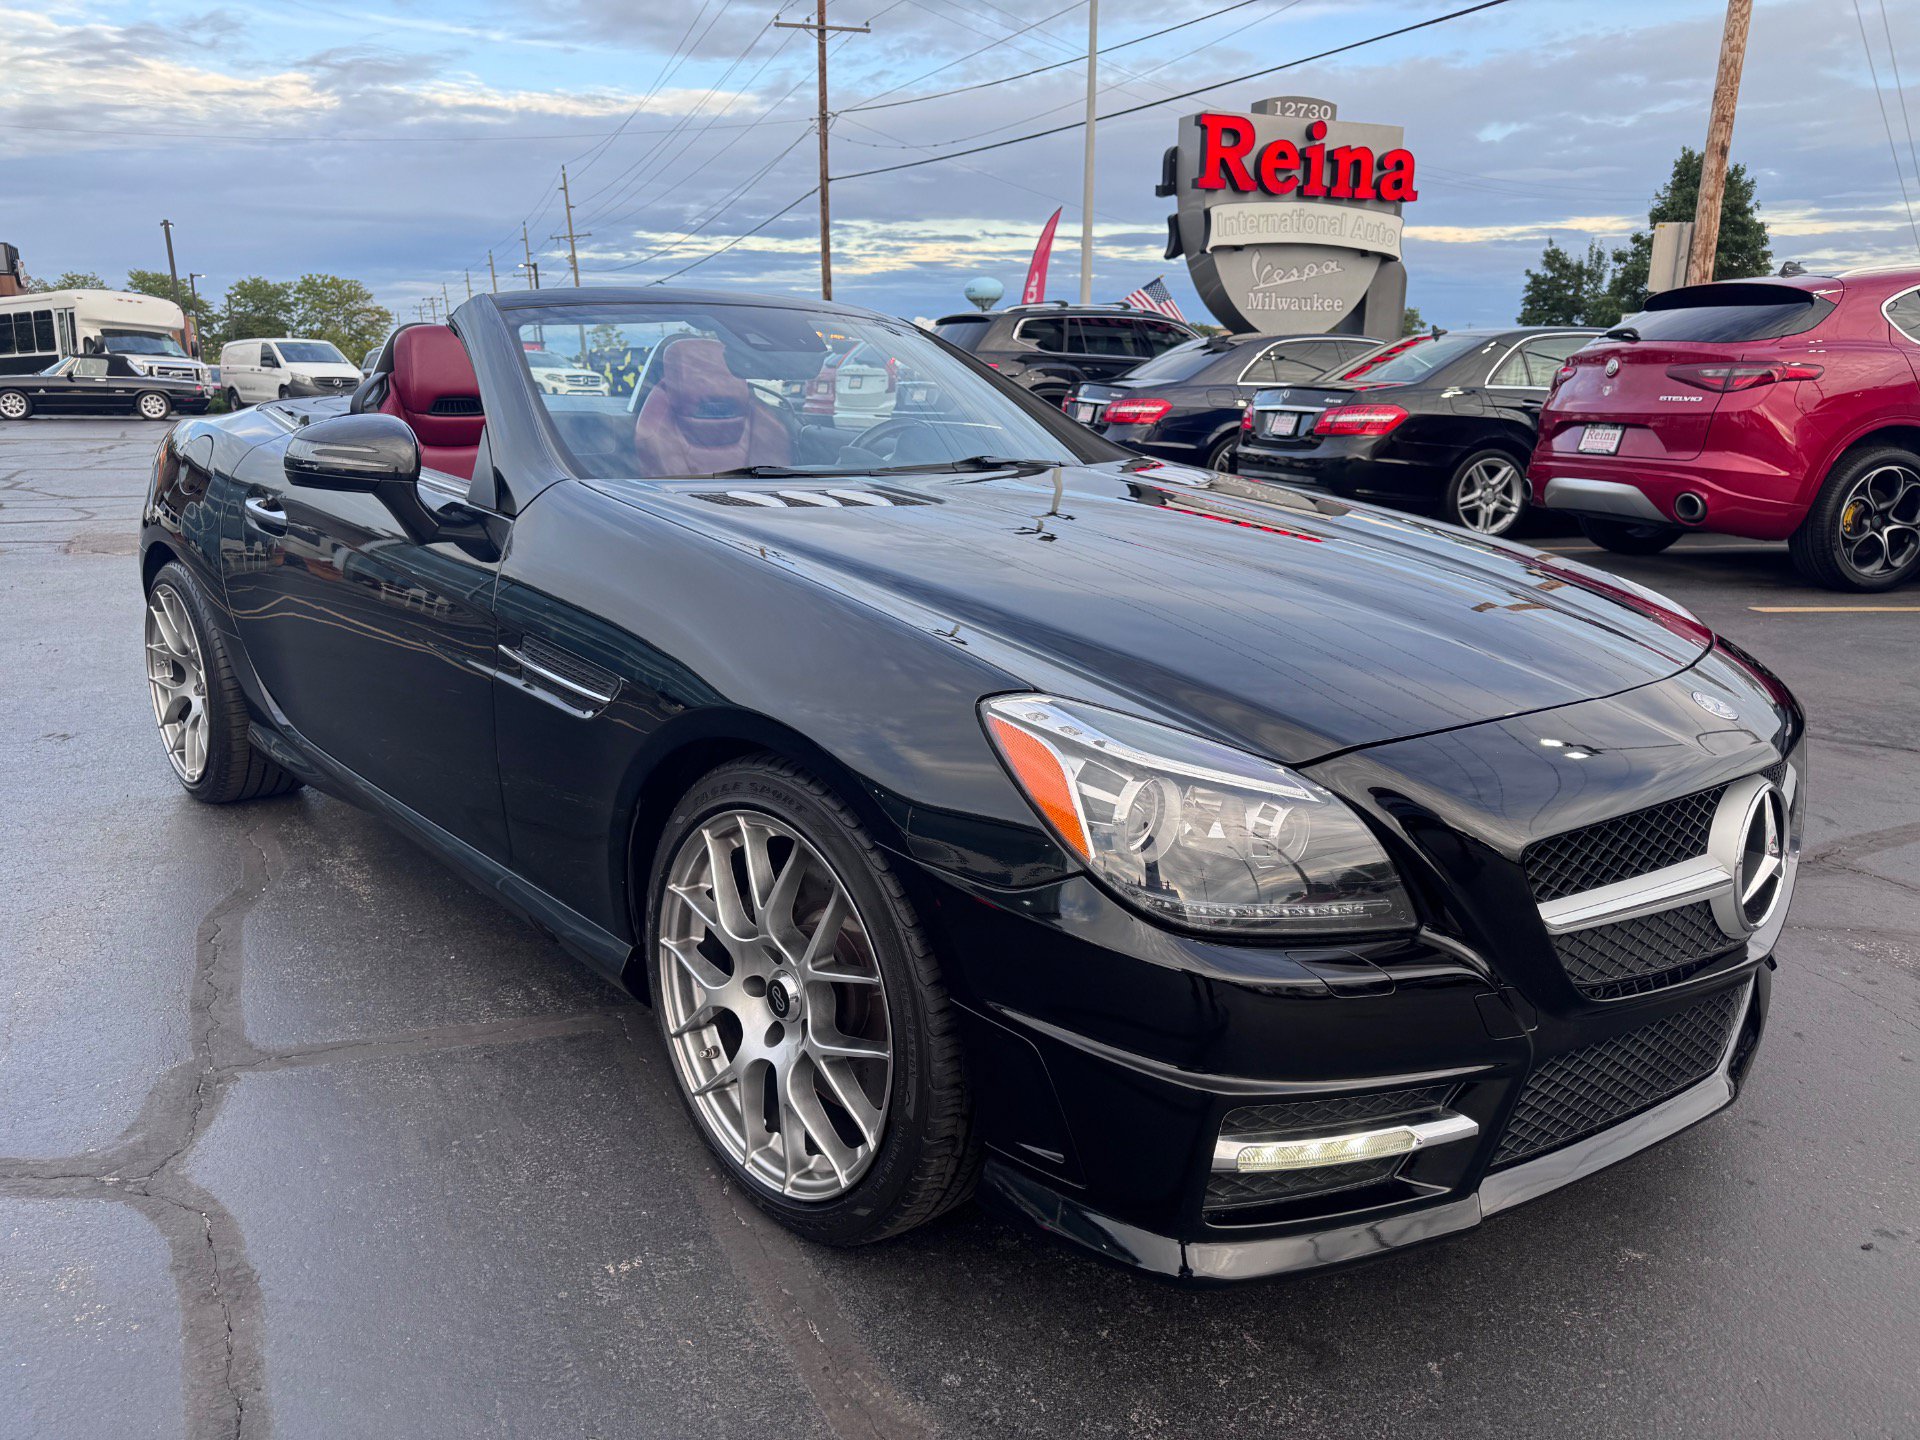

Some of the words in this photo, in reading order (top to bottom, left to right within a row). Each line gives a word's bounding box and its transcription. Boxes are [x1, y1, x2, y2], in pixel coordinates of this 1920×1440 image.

[1274, 101, 1332, 120] 12730
[1196, 114, 1418, 203] Reina
[1217, 209, 1347, 237] International
[1351, 215, 1397, 247] Auto
[1252, 250, 1344, 290] Vespa
[1247, 293, 1343, 311] Milwaukee
[1586, 429, 1617, 441] Reina
